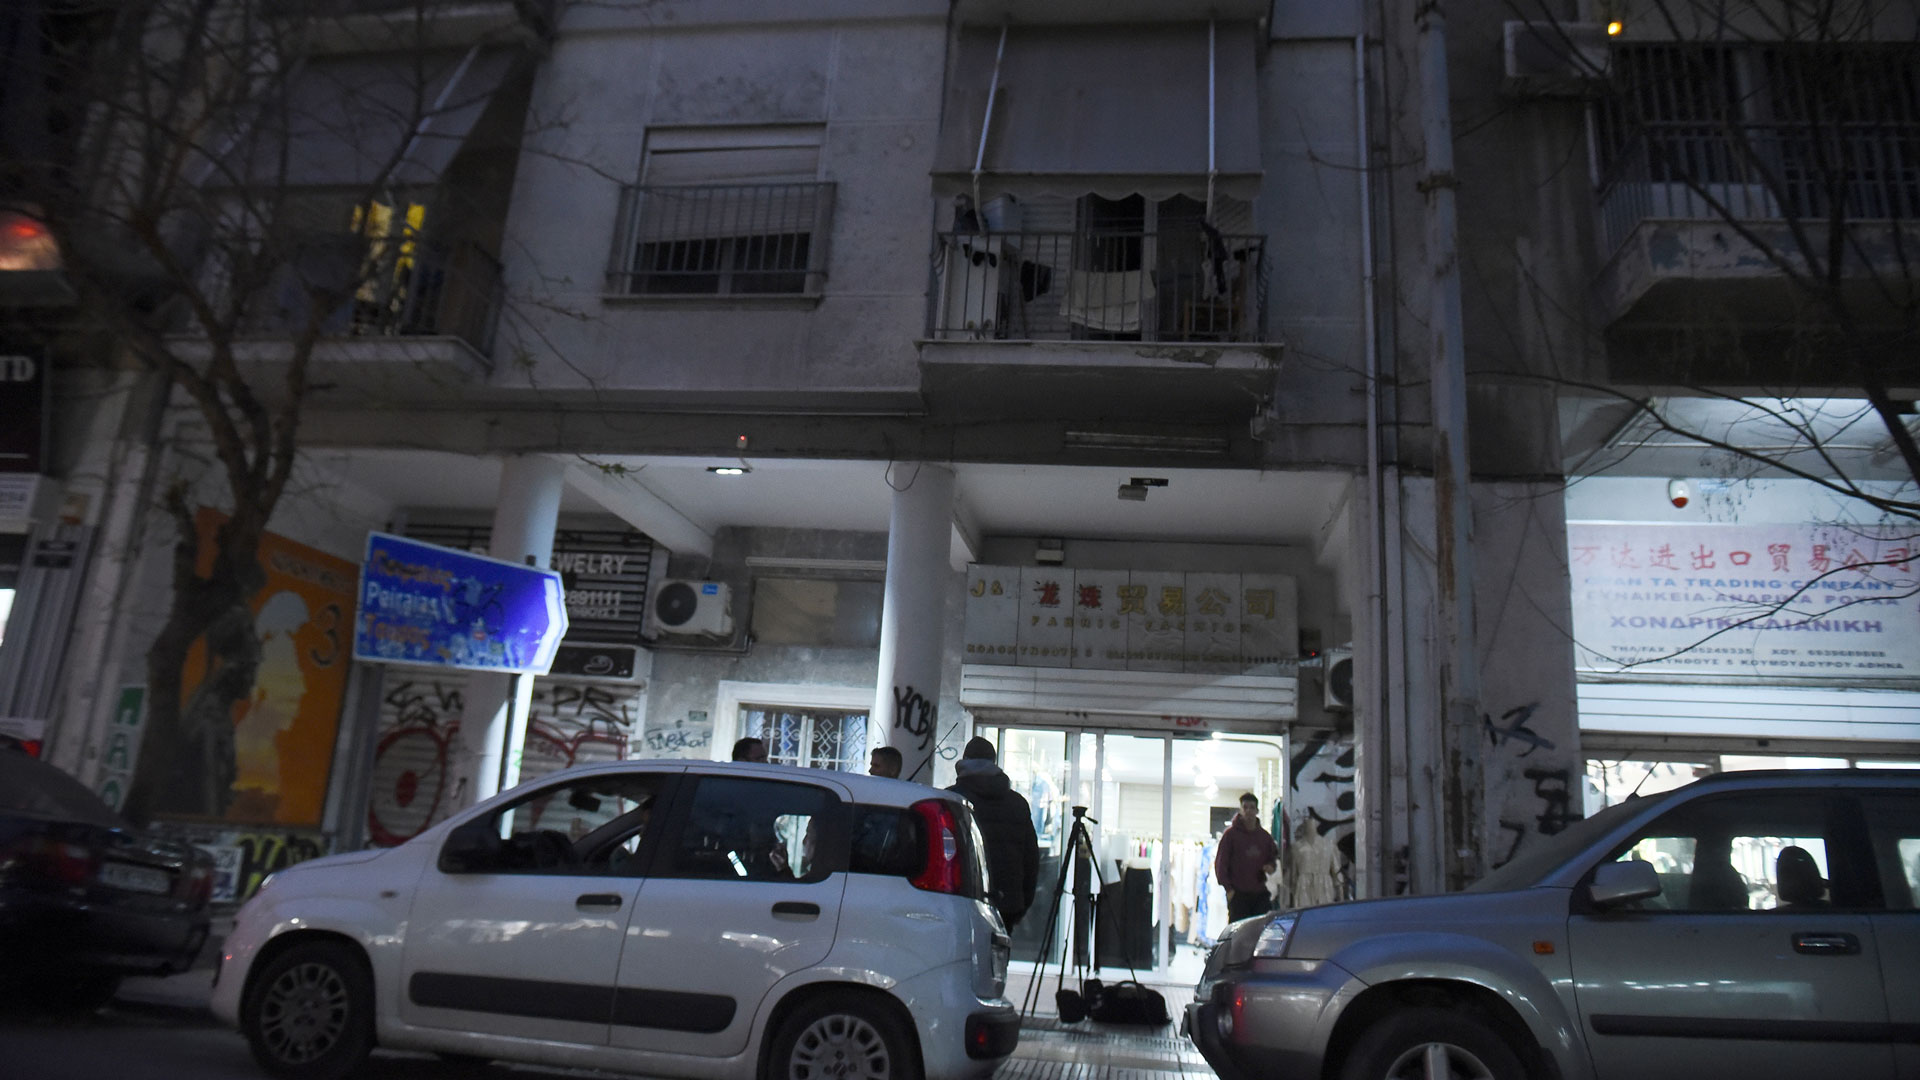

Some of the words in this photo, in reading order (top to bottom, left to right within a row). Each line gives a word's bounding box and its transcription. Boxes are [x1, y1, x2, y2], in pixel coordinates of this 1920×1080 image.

[552, 552, 627, 574] WELRY
[1651, 578, 1676, 587] TA
[1685, 578, 1782, 590] TRADING
[1790, 580, 1894, 591] COMPANY
